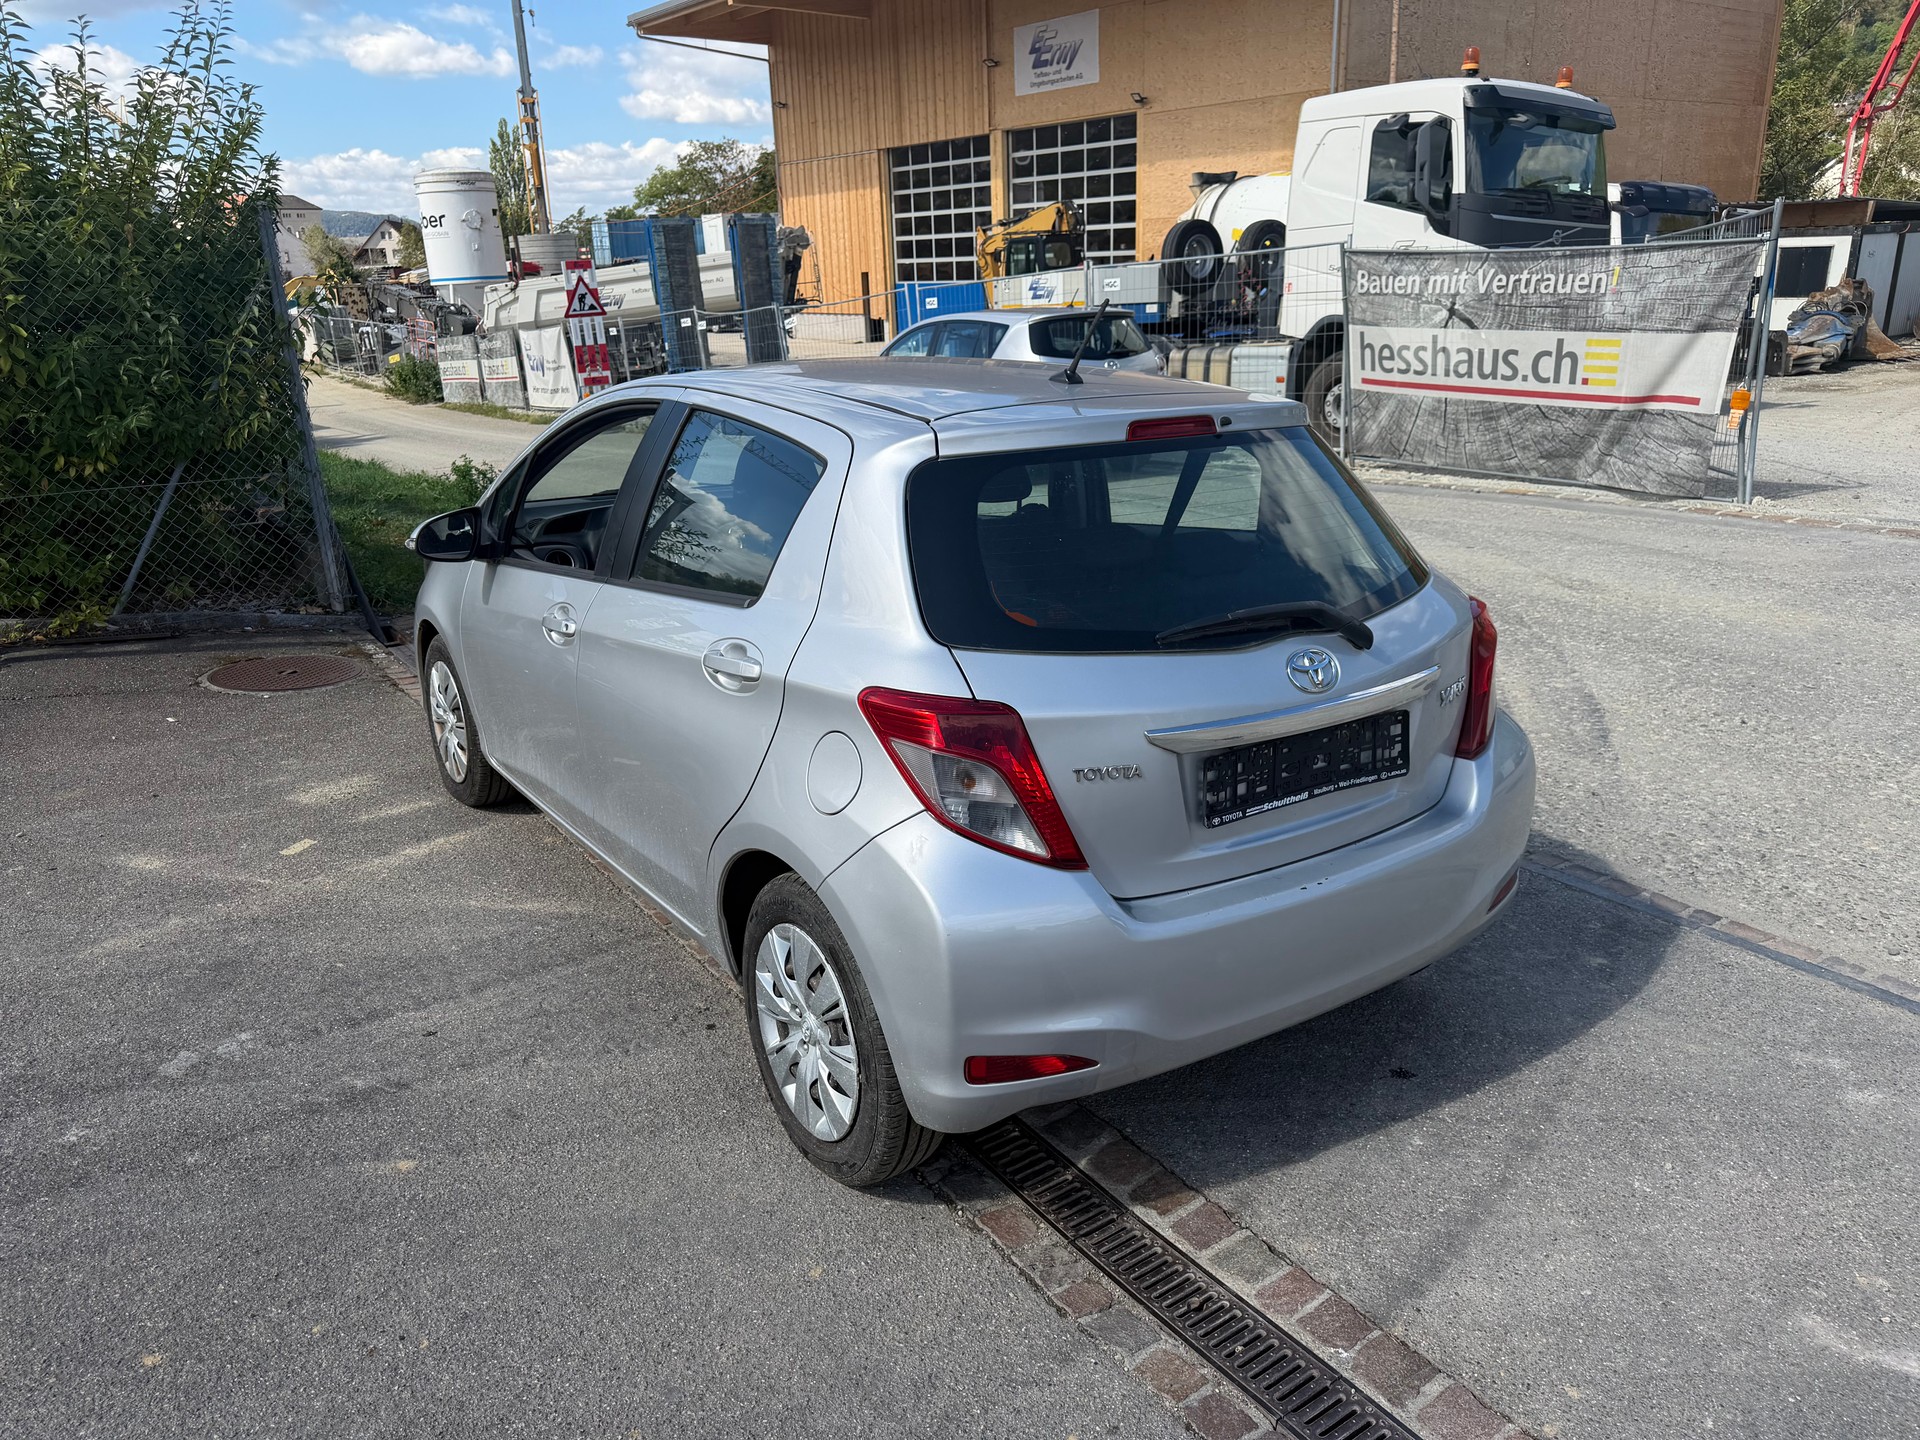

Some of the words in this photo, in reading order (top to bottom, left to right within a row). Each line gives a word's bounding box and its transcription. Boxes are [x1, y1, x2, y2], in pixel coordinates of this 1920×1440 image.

[1356, 269, 1421, 295] Bauen
[1428, 268, 1467, 294] mit
[1477, 264, 1620, 295] Vertrauen!
[1359, 331, 1580, 387] hesshaus.ch
[1072, 764, 1142, 783] TOYOTA
[1222, 811, 1243, 822] TOYOTA
[1263, 791, 1309, 810] Schultheiß
